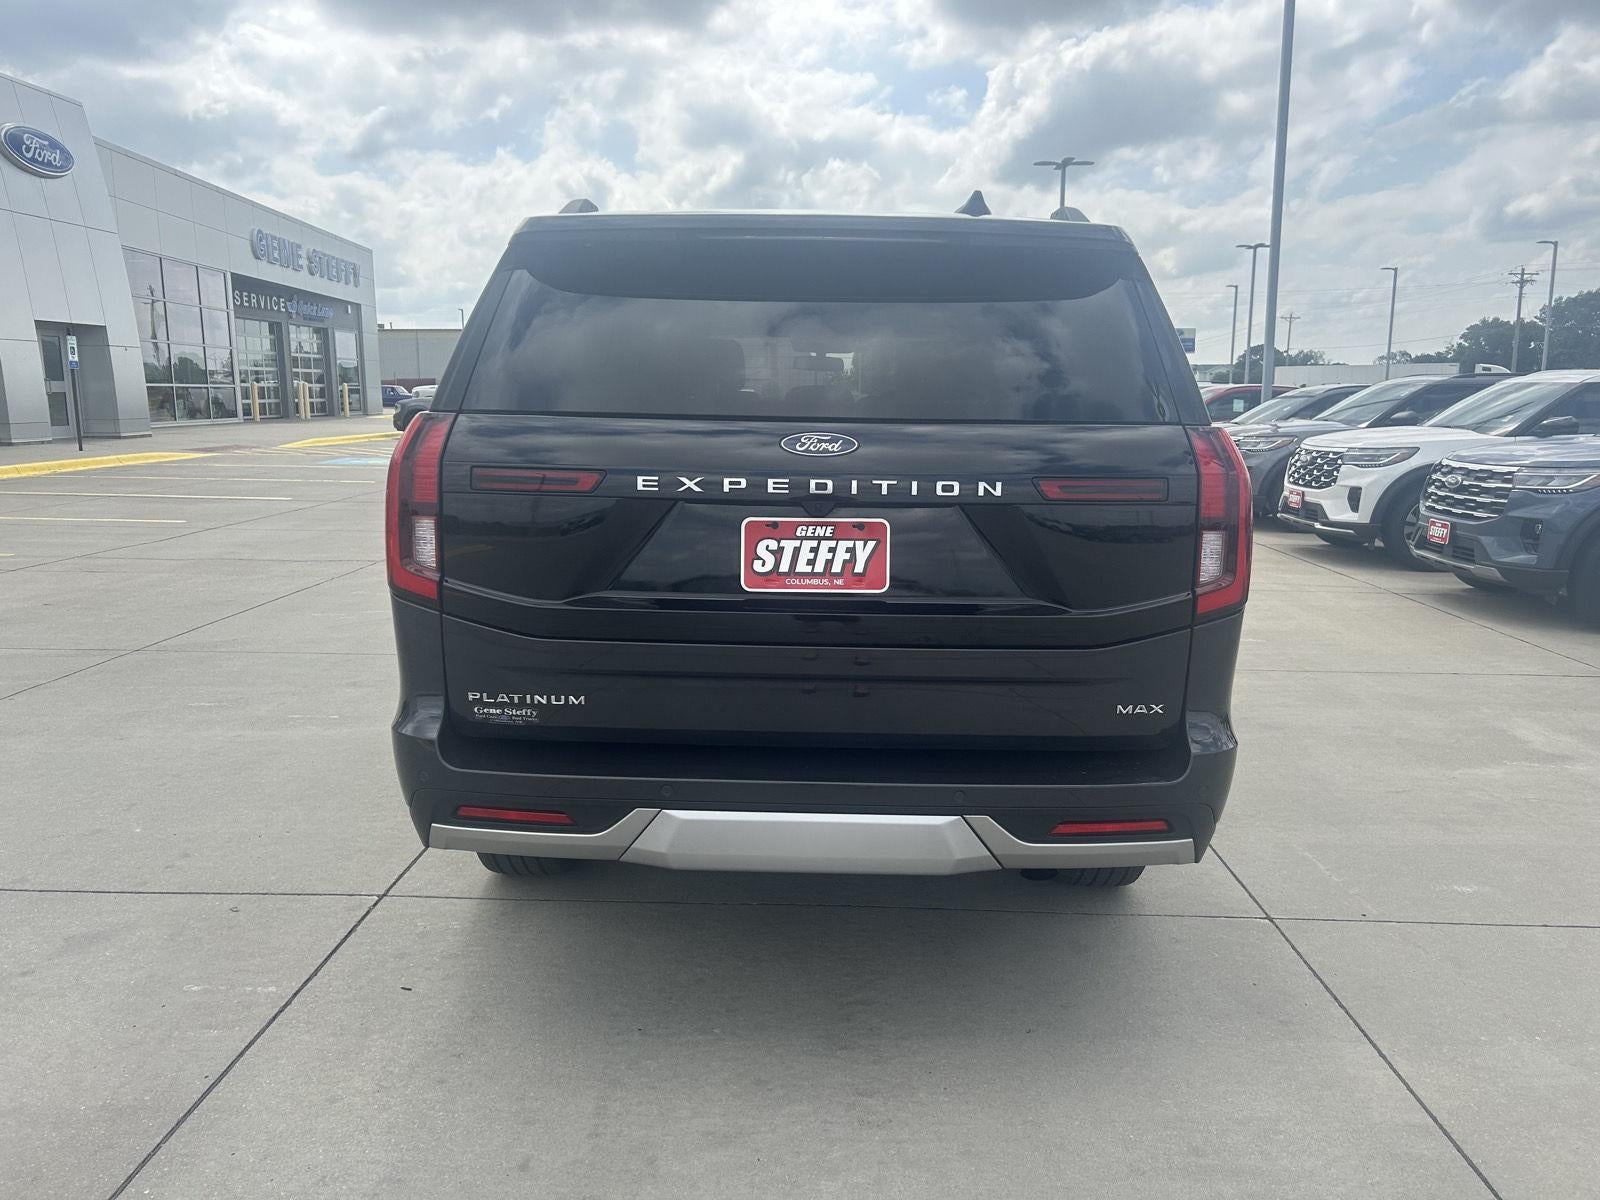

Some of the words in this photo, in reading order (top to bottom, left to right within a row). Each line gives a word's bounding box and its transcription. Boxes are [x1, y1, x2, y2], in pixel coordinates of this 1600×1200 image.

[22, 133, 62, 167] Ford
[249, 228, 304, 272] GENE
[306, 247, 361, 288] STEFFY
[234, 290, 286, 312] SERVICE
[795, 435, 843, 452] Ford
[636, 475, 1003, 497] EXPEDITION
[795, 525, 835, 537] GENE
[752, 538, 877, 574] STEFFY
[785, 578, 831, 586] COLUMBUS,
[467, 691, 586, 705] PLATINUM
[474, 706, 502, 715] Gene
[504, 707, 538, 718] Steffy
[1116, 703, 1165, 714] MAX
